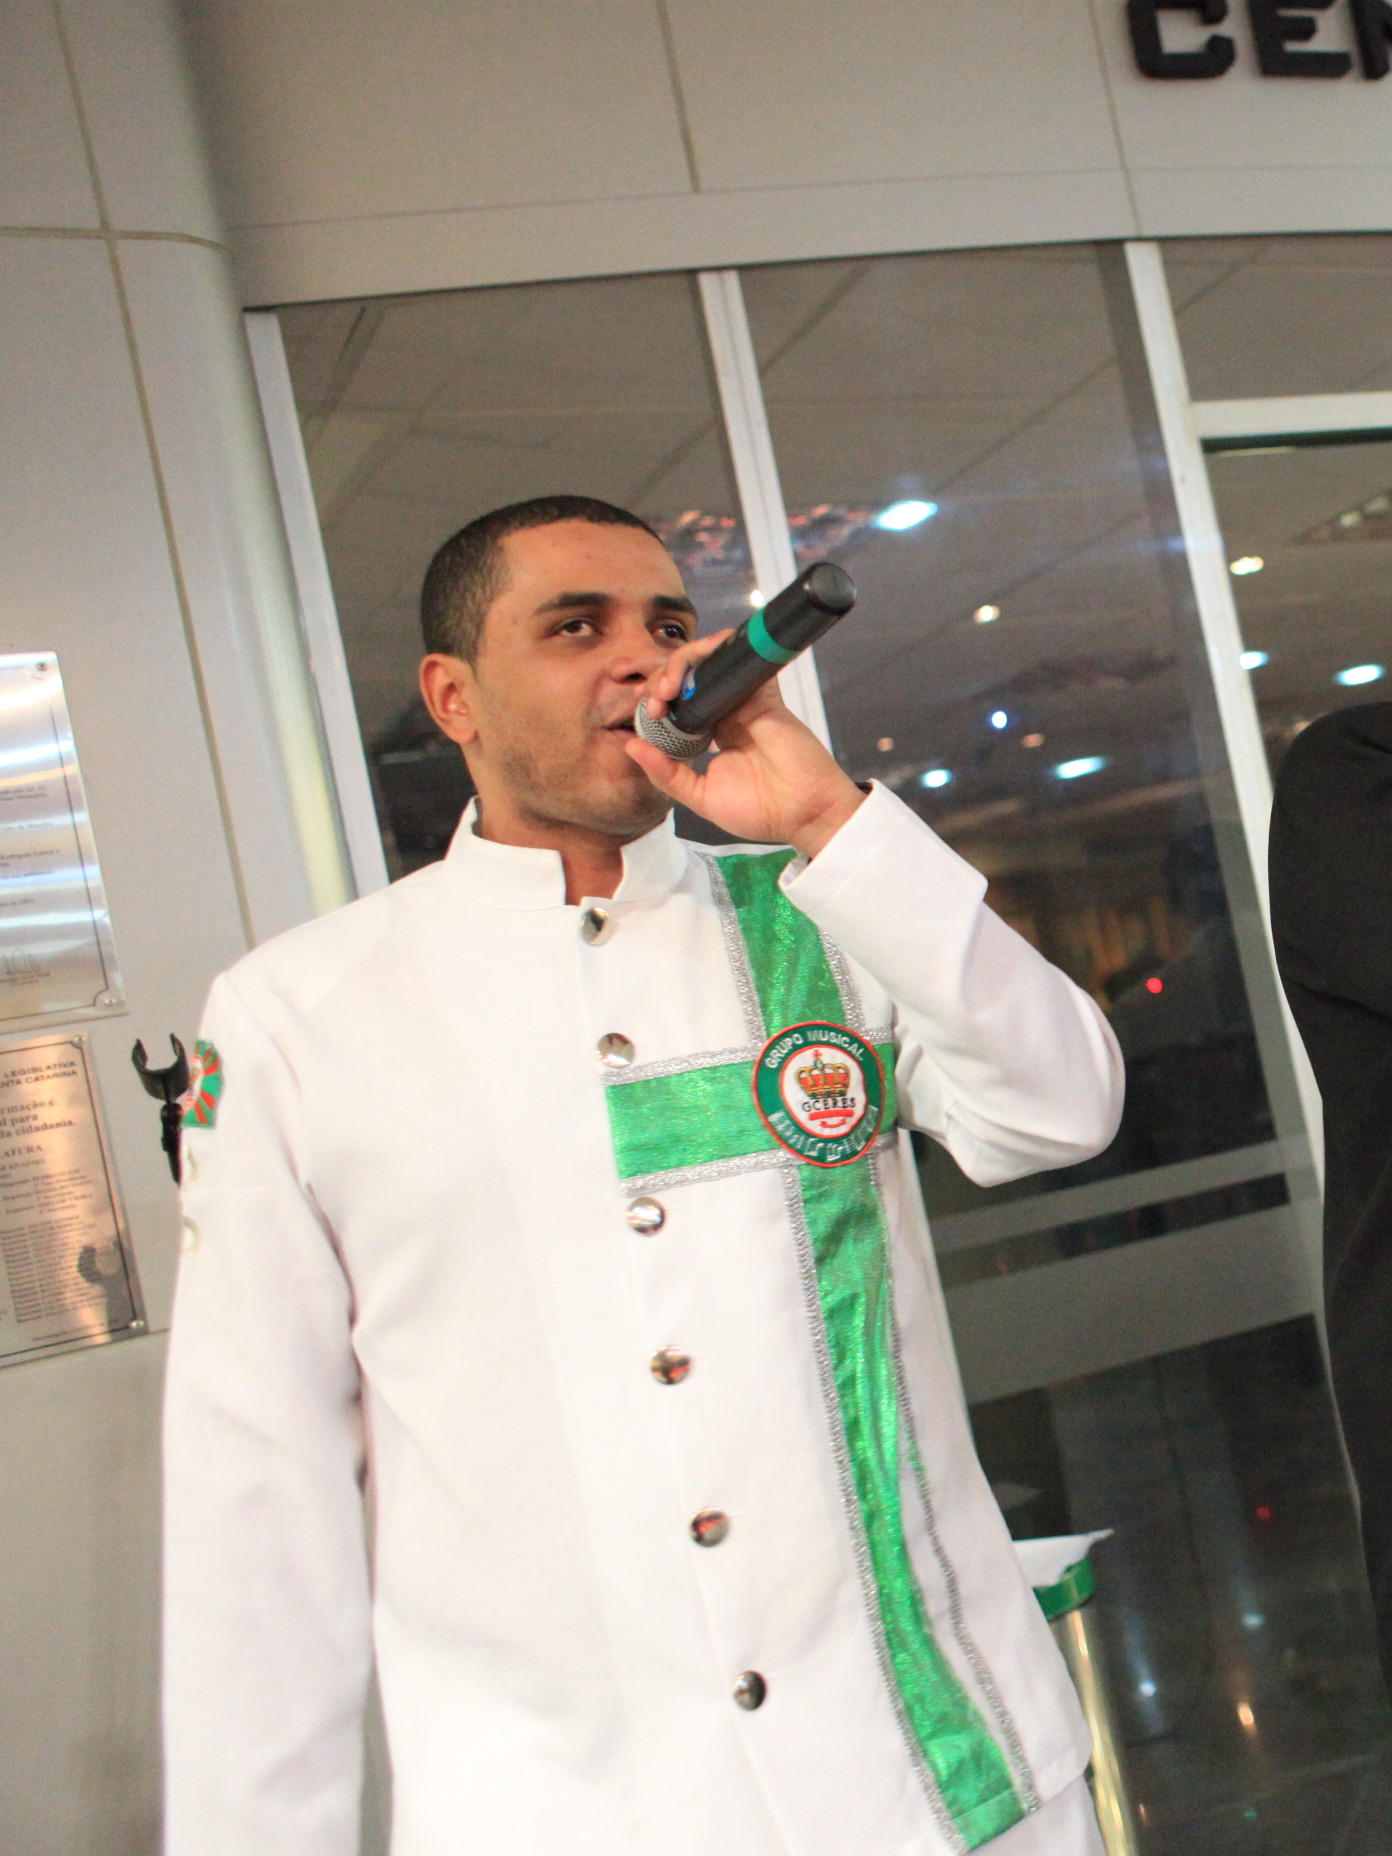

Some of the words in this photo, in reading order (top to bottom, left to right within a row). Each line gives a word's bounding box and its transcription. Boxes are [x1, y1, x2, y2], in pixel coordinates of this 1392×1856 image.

[765, 1033, 804, 1069] GRUPO
[806, 1030, 865, 1061] MUSICAL
[4, 1061, 76, 1078] LEGISLATIVA
[802, 1097, 856, 1112] GCERES
